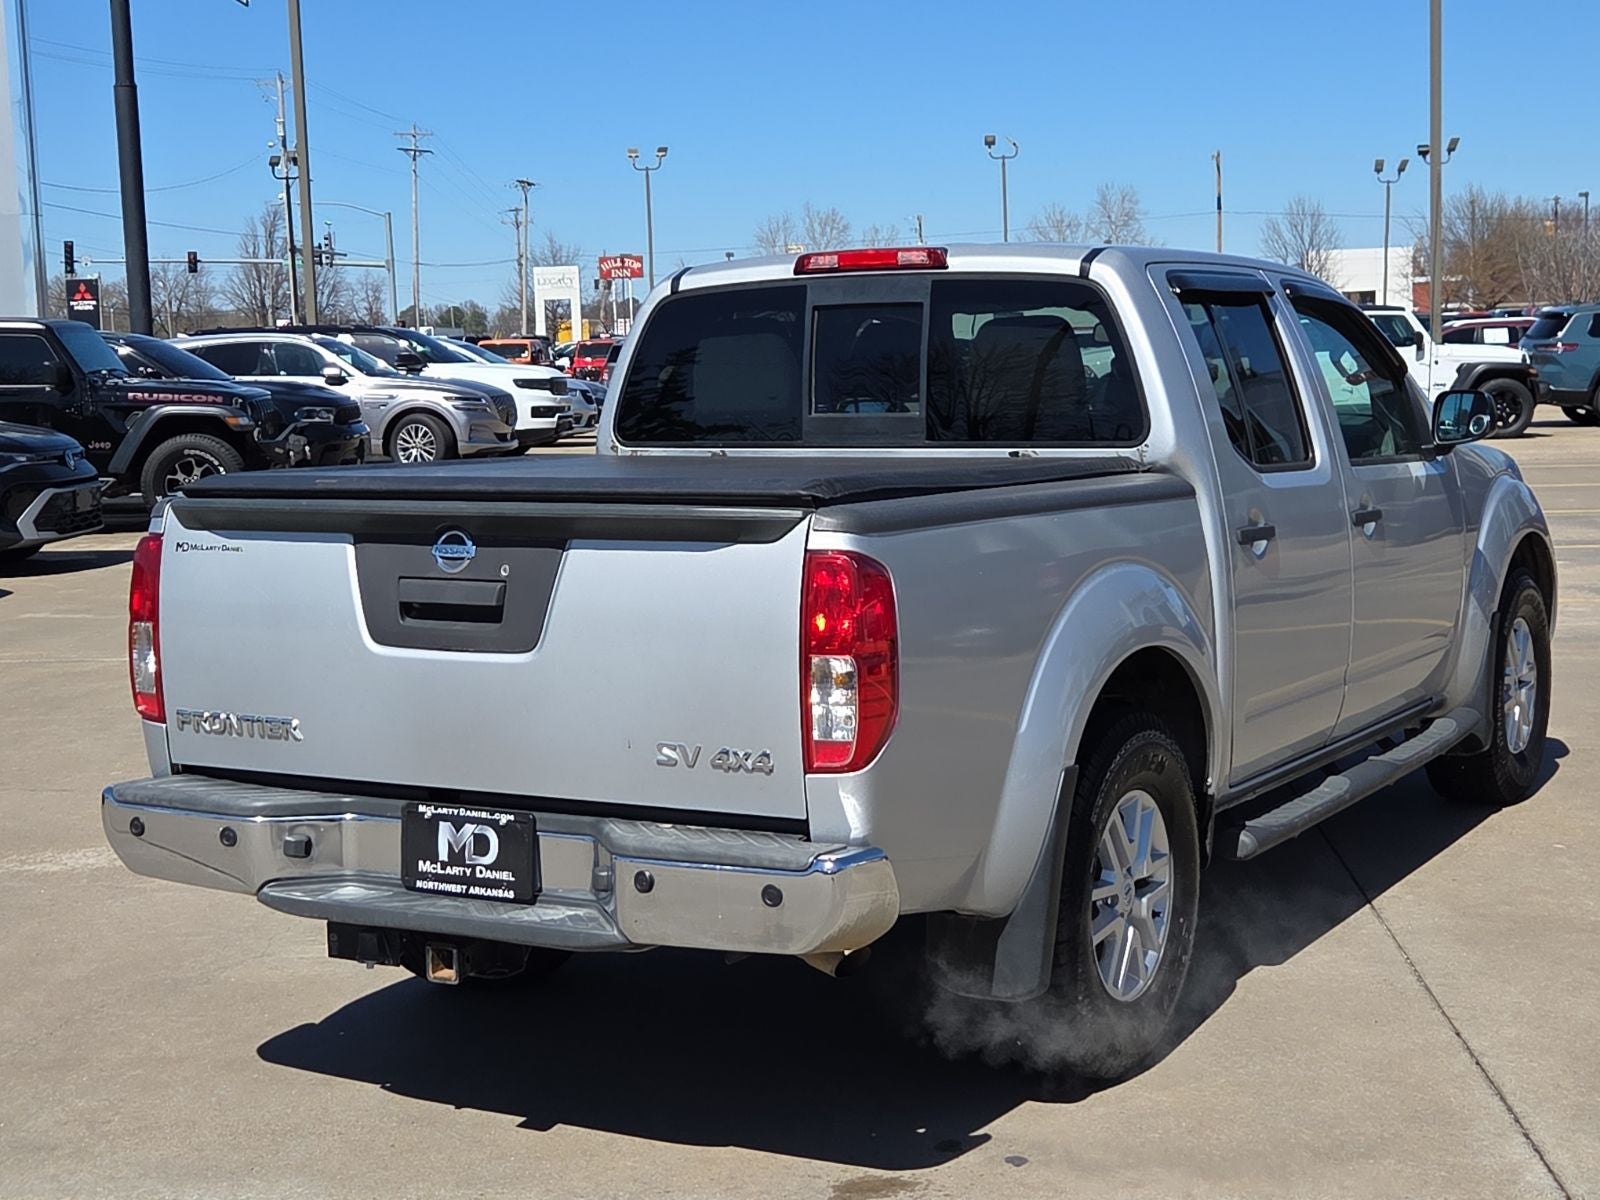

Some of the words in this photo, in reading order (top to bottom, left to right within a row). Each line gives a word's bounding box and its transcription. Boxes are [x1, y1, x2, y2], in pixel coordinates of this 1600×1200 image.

[600, 258, 622, 271] HILL
[623, 258, 642, 269] TOP
[611, 268, 631, 277] INN
[127, 392, 224, 403] RUBICON
[88, 440, 111, 449] Jeep
[434, 545, 471, 555] NISSAN
[176, 709, 304, 742] FRONTIER
[656, 742, 701, 768] SV
[437, 820, 499, 865] MD
[475, 865, 516, 881] DANIEL
[415, 879, 467, 894] NORTHWEST
[468, 885, 515, 899] ARKANSAS
